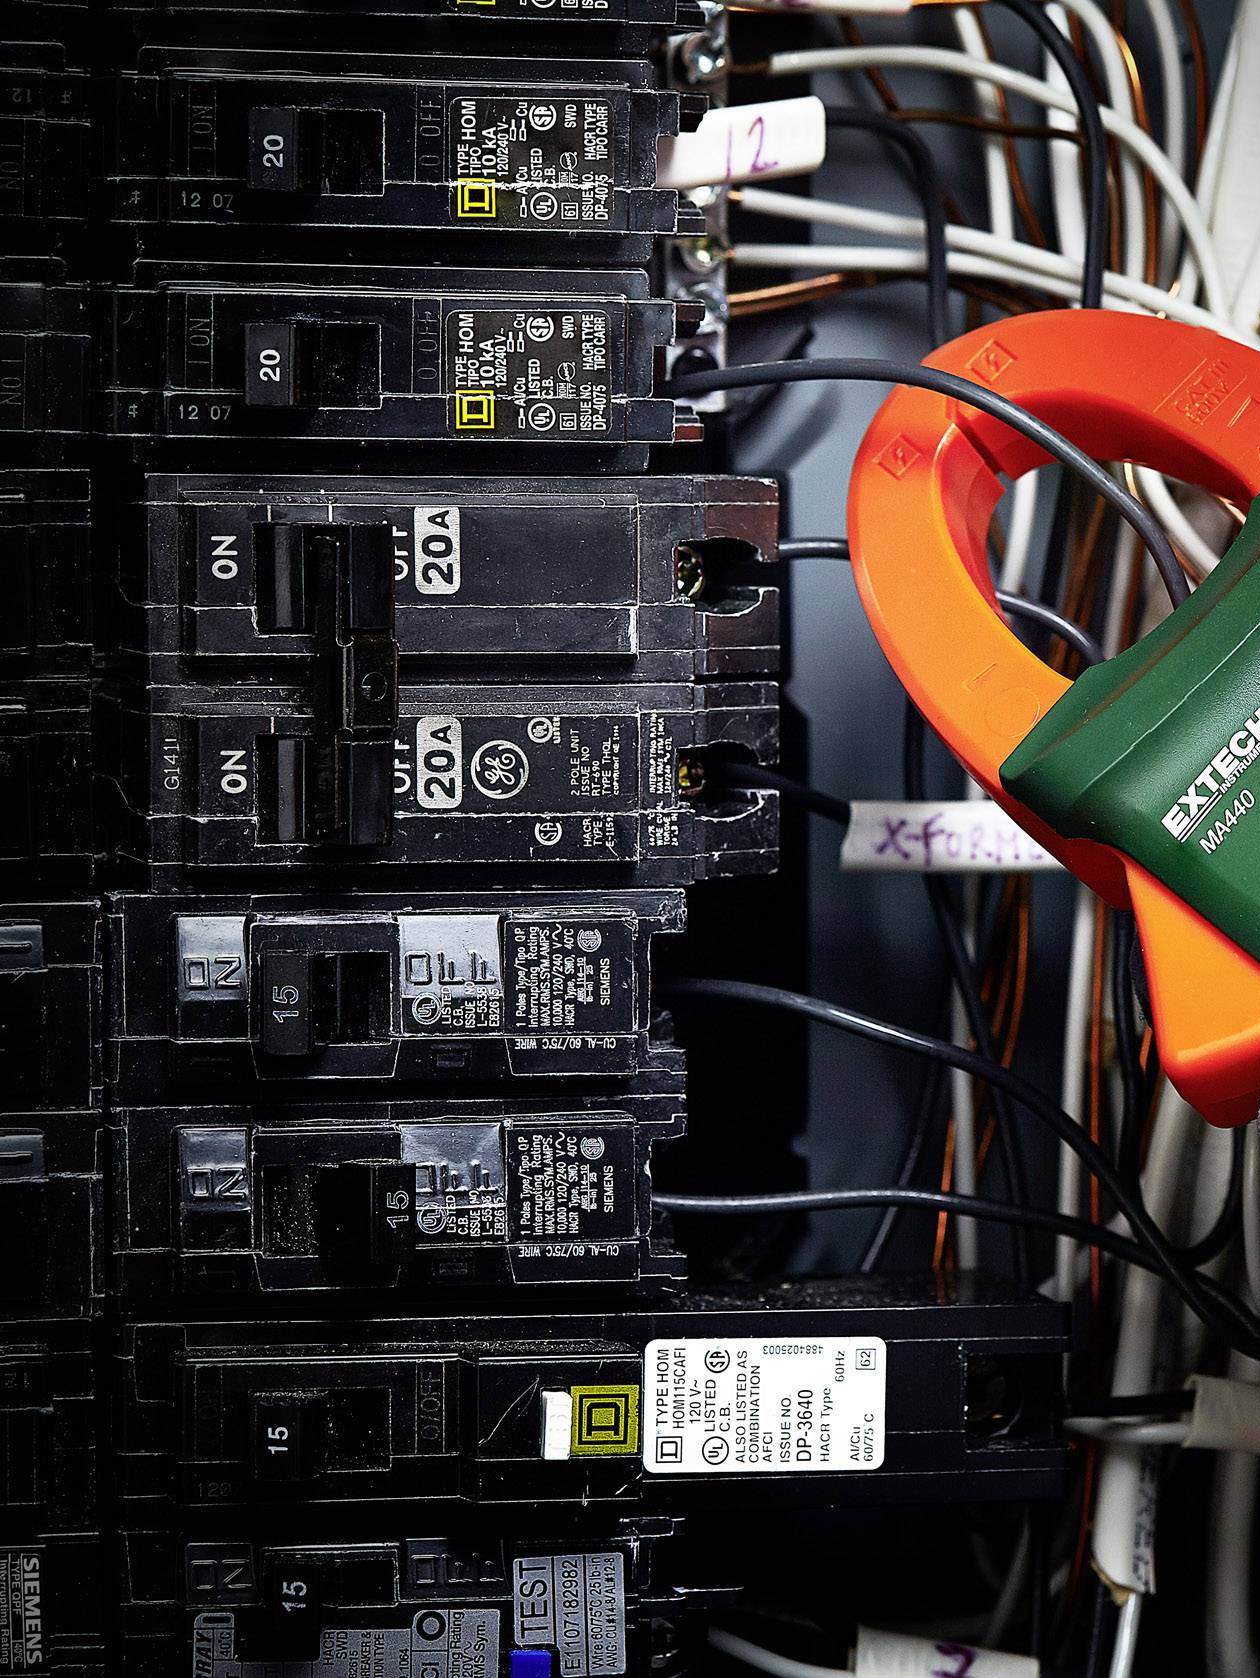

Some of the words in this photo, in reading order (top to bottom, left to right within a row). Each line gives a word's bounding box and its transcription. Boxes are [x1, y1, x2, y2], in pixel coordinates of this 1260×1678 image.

[461, 101, 476, 141] HOM
[515, 101, 528, 117] Cu
[565, 104, 577, 128] SWD
[584, 103, 597, 129] TYPE
[597, 105, 609, 136] CARR
[262, 134, 284, 168] 20
[482, 127, 497, 149] kA
[584, 129, 596, 161] HACR
[596, 136, 609, 160] TIPO
[457, 143, 470, 175] TYPE
[469, 147, 482, 175] TIPO
[482, 154, 497, 177] 10
[497, 133, 509, 177] 120/240
[181, 191, 201, 207] 12
[212, 193, 234, 209] 07
[582, 188, 594, 220] ISSUE
[595, 174, 609, 220] DP-4075
[458, 313, 474, 352] HOM
[513, 313, 526, 329] Cu
[562, 315, 574, 339] SWD
[582, 314, 594, 341] TYPE
[594, 316, 606, 348] CARR
[259, 349, 281, 382] 20
[479, 339, 495, 361] kA
[495, 345, 507, 387] 120/240
[582, 341, 594, 370] HACR
[594, 348, 606, 371] TIPO
[455, 355, 467, 387] TYPE
[467, 359, 479, 387] TIPO
[479, 365, 495, 388] 10
[528, 358, 540, 399] LISTED
[179, 404, 199, 420] 12
[210, 405, 232, 420] 07
[580, 401, 592, 430] ISSUE
[593, 384, 606, 430] DP-4075
[210, 536, 239, 580] ON
[421, 510, 454, 585] 20A
[570, 728, 580, 753] UNIT
[581, 746, 591, 762] NO
[220, 750, 247, 794] ON
[423, 725, 456, 800] 20A
[570, 758, 580, 785] POLE
[591, 760, 600, 797] RT-690
[581, 766, 591, 796] ISSUE
[601, 770, 612, 796] TYPE
[583, 818, 592, 847] HACR
[593, 821, 603, 846] TYPE
[1199, 790, 1255, 854] MA440
[528, 926, 540, 960] Rating
[183, 956, 242, 990] ON
[405, 950, 498, 986] OFF
[552, 953, 565, 995] 120/240
[600, 957, 611, 1006] SIEMENS
[272, 985, 300, 1023] 15
[441, 986, 452, 1025] LISTED
[528, 967, 540, 1027] Interrupting
[465, 1000, 476, 1028] ISSUE
[564, 1003, 575, 1027] HACR
[514, 1038, 538, 1050] WIRE
[586, 1037, 617, 1049] CU-AL
[531, 1134, 543, 1168] Rating
[556, 1161, 570, 1202] 120/240
[603, 1165, 614, 1213] SIEMENS
[387, 1190, 409, 1229] 15
[532, 1174, 545, 1236] Interrupting
[569, 1211, 579, 1234] HACR
[518, 1246, 541, 1257] WIRE
[588, 1245, 620, 1256] CU-AL
[656, 1349, 670, 1383] HOM
[736, 1350, 748, 1369] AS
[835, 1350, 845, 1382] 60Hz
[860, 1350, 871, 1367] 62
[672, 1347, 686, 1429] HOM115CAFI
[736, 1373, 747, 1421] LISTED
[820, 1387, 833, 1419] Type
[656, 1388, 669, 1427] TYPE
[689, 1401, 701, 1424] 120
[704, 1379, 717, 1432] LISTED
[719, 1402, 731, 1432] C.B.
[748, 1365, 761, 1463] COMBINATION
[267, 1426, 289, 1455] 15
[796, 1389, 814, 1462] DP-3640
[735, 1428, 747, 1463] ALSO
[762, 1431, 773, 1463] AFCI
[780, 1421, 791, 1463] ISSUE
[820, 1423, 830, 1462] HACR
[11, 1558, 20, 1588] TYPE
[24, 1558, 42, 1664] SIEMENS
[282, 1581, 307, 1612] 15
[519, 1561, 549, 1639] TEST
[450, 1612, 464, 1648] Rating
[562, 1559, 581, 1671] E1107182982
[323, 1631, 334, 1666] HACR
[336, 1631, 348, 1659] SWD
[474, 1621, 489, 1652] Sym.
